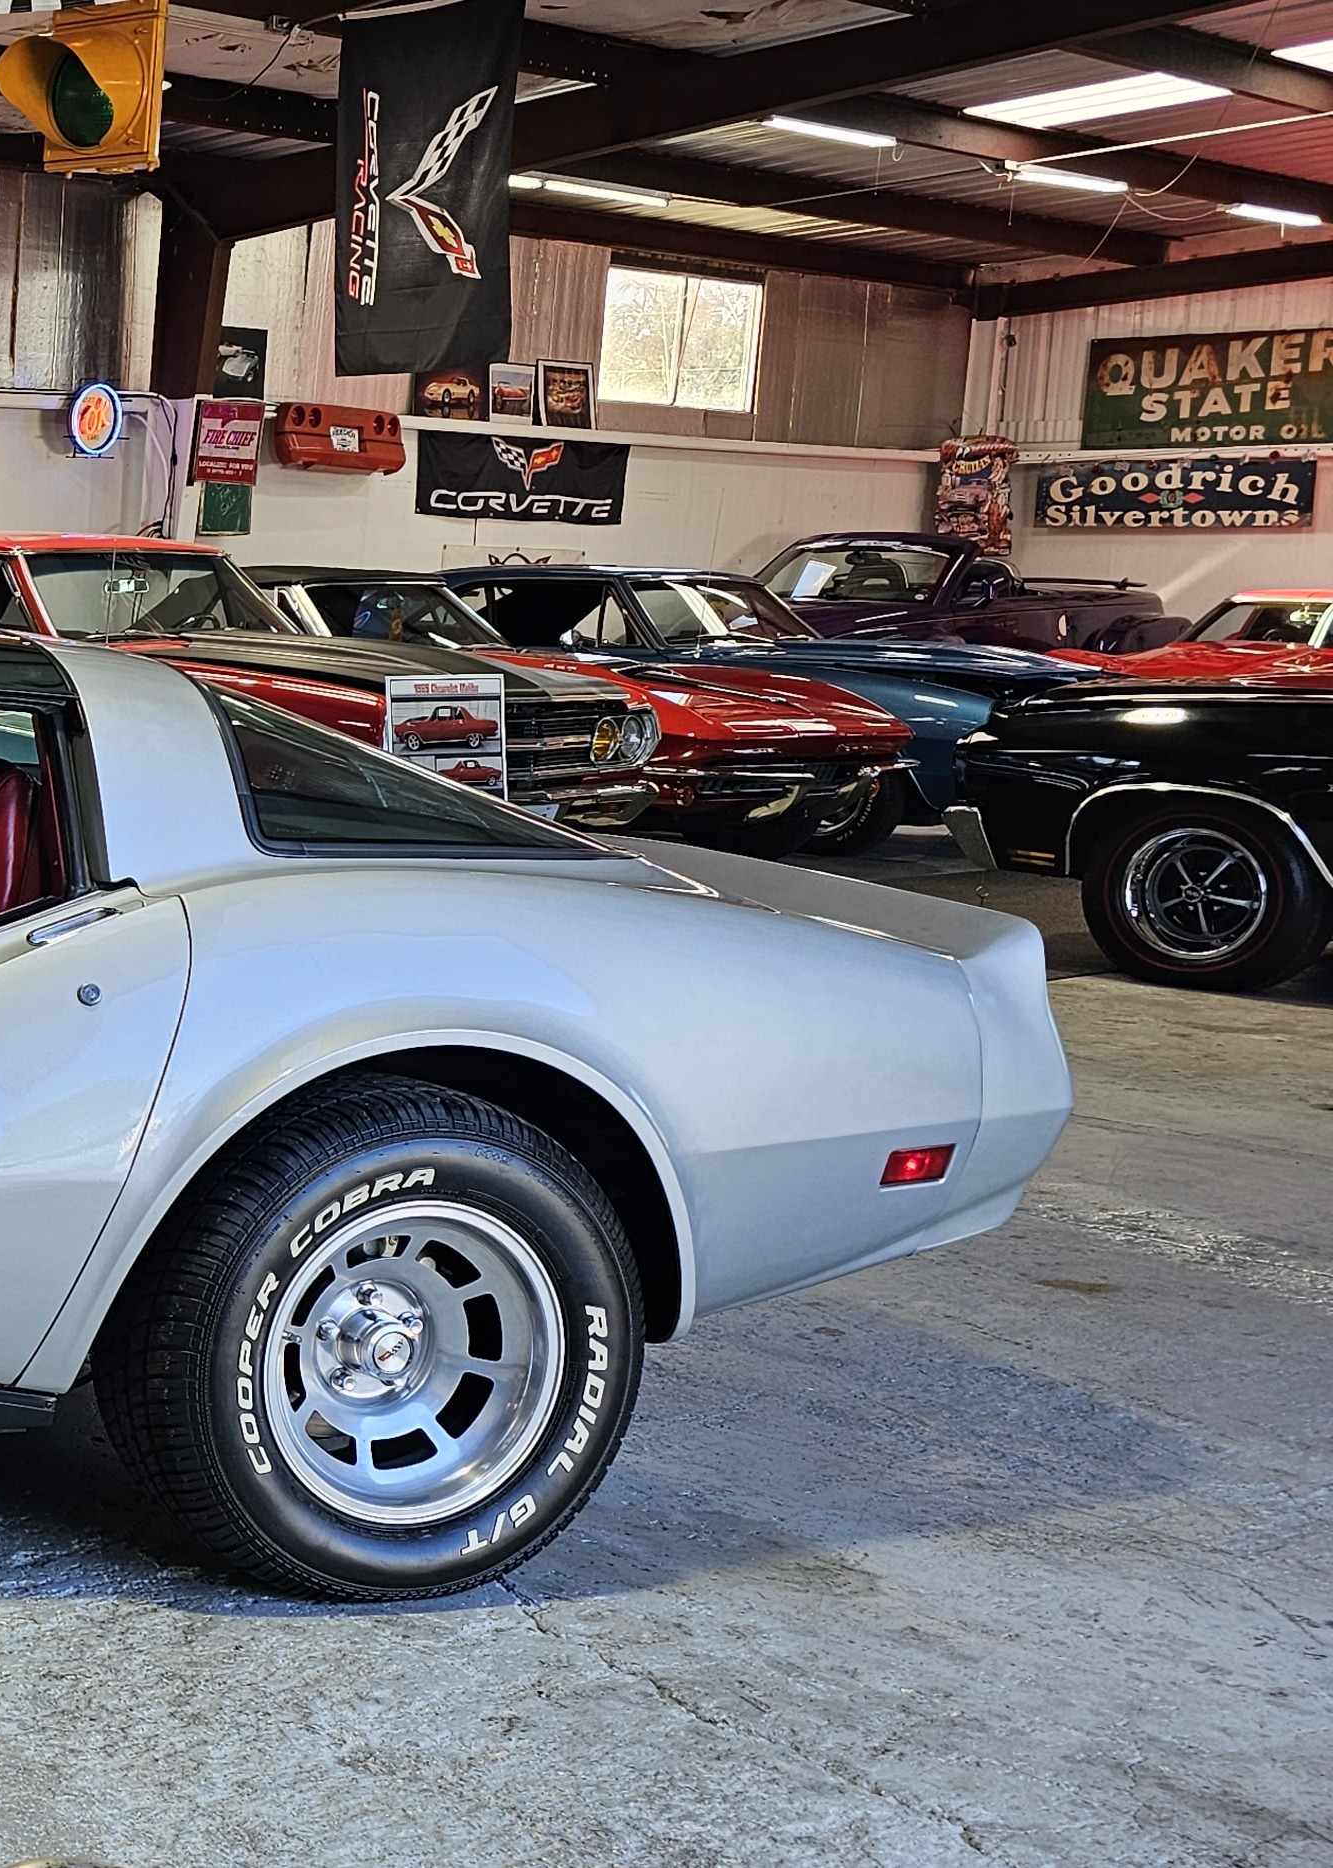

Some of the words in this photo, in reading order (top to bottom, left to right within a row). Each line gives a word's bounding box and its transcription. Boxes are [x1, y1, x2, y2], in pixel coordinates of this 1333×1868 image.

[349, 88, 369, 299] RACING
[360, 90, 380, 306] CORVETTE
[1097, 329, 1333, 397] QUAKER
[1140, 381, 1292, 423] STATE
[203, 429, 225, 444] FIRE
[226, 430, 257, 447] CHIEF
[1170, 425, 1266, 443] MOTOR
[430, 489, 613, 518] CORVETTE
[1049, 463, 1300, 505] Goodrich
[1045, 504, 1300, 528] Silvertowns
[235, 1271, 282, 1475] COOPER
[290, 1166, 436, 1259] COBRA
[545, 1302, 610, 1477] RADIAL
[460, 1493, 538, 1558] G/T
